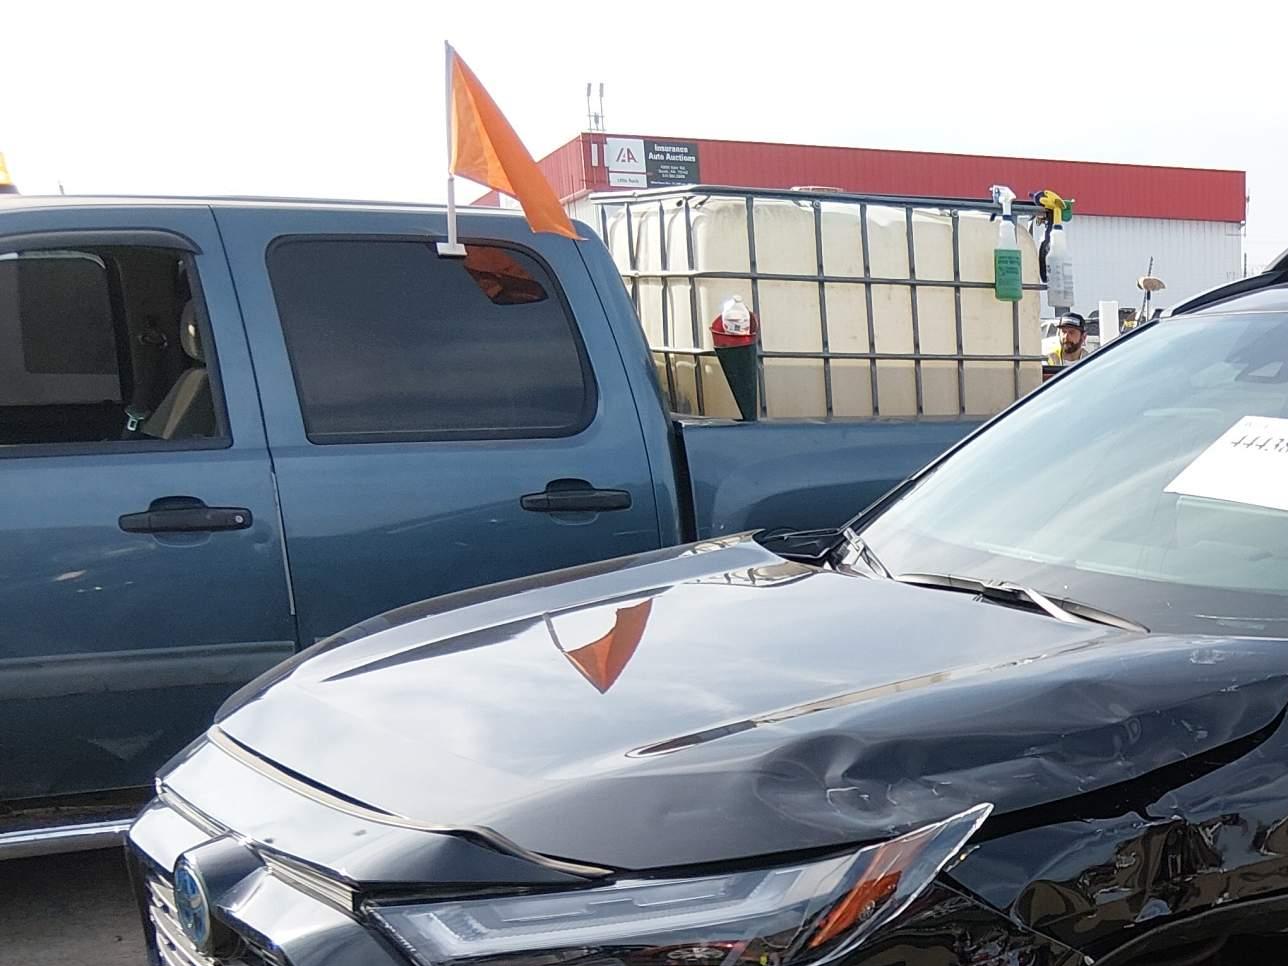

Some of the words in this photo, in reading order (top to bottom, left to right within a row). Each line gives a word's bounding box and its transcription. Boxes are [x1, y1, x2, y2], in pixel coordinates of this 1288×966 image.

[654, 143, 689, 153] Insurance
[648, 152, 665, 160] Auto
[666, 152, 696, 162] Auctions
